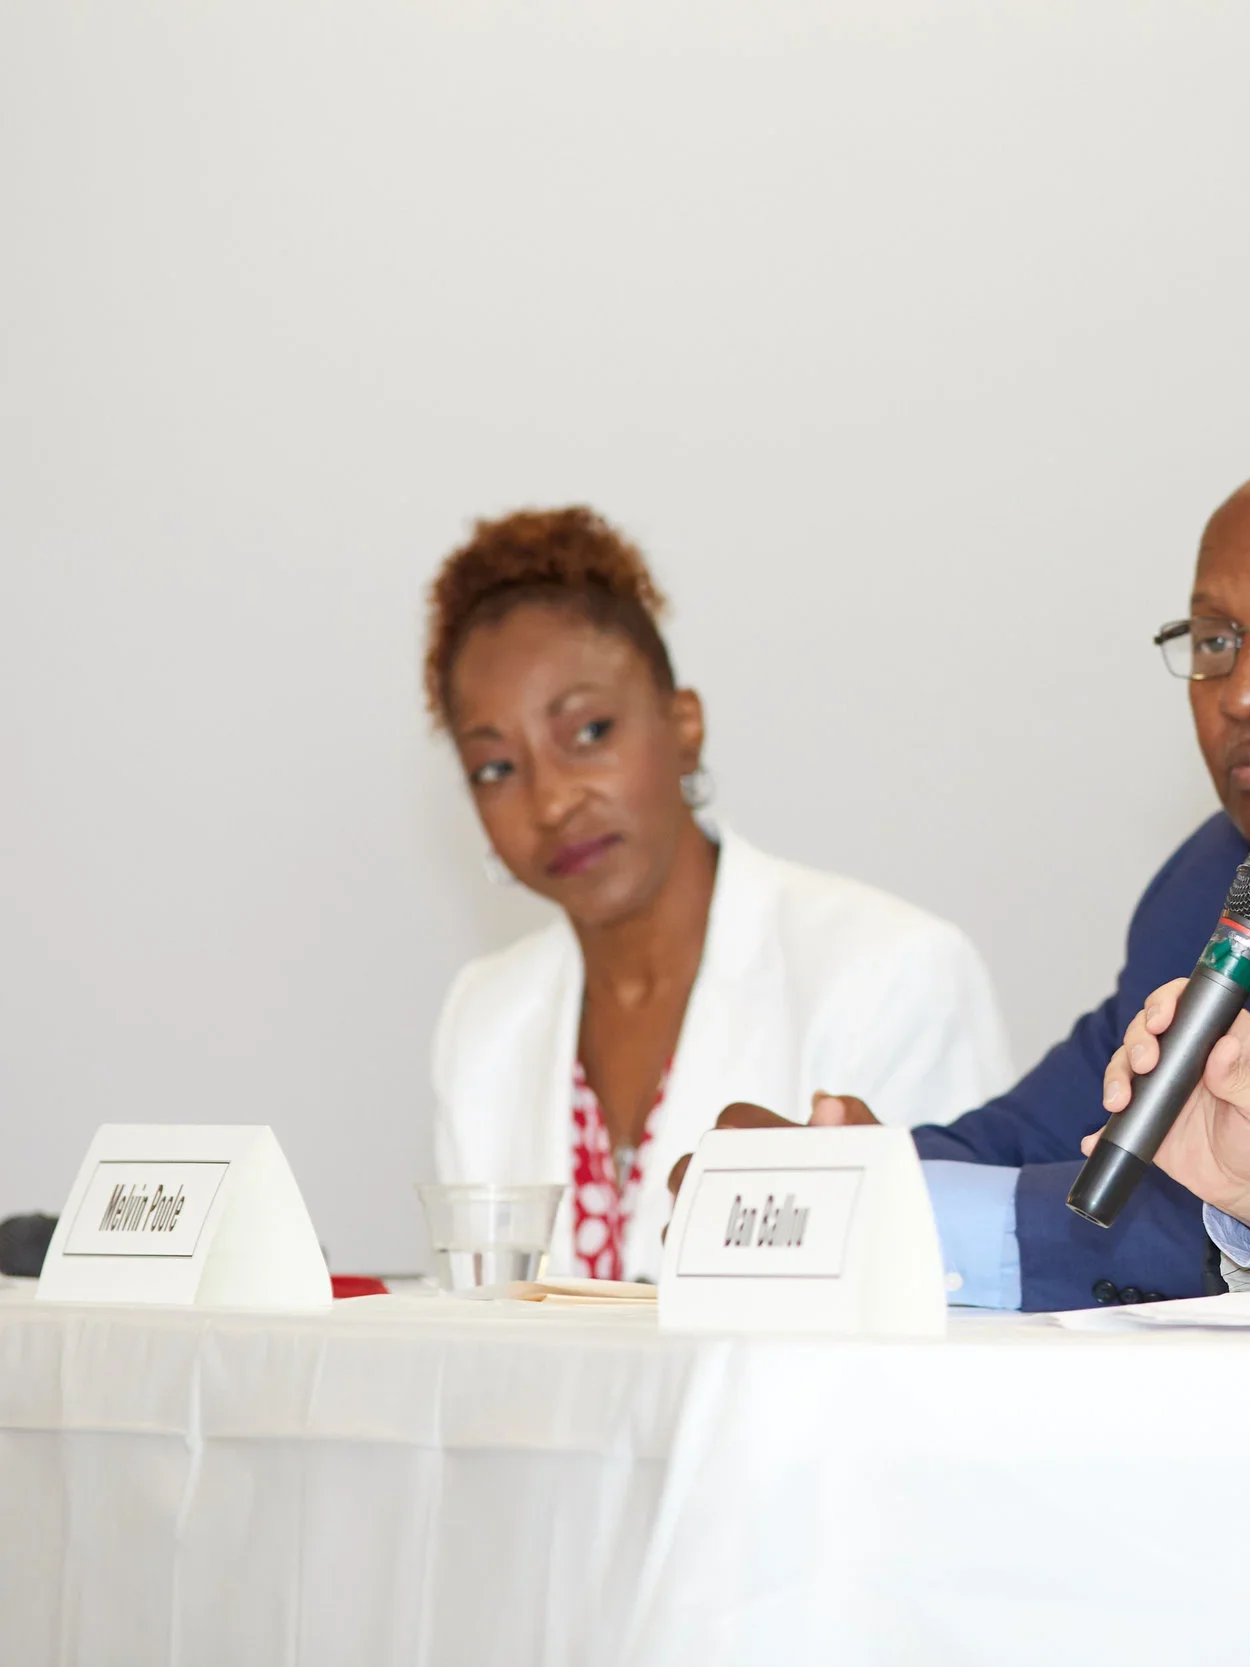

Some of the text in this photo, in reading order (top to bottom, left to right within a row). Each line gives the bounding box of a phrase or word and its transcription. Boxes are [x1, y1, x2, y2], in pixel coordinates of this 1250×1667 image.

[99, 1184, 185, 1232] Melvin Poole
[724, 1194, 810, 1247] Dan Ballou
